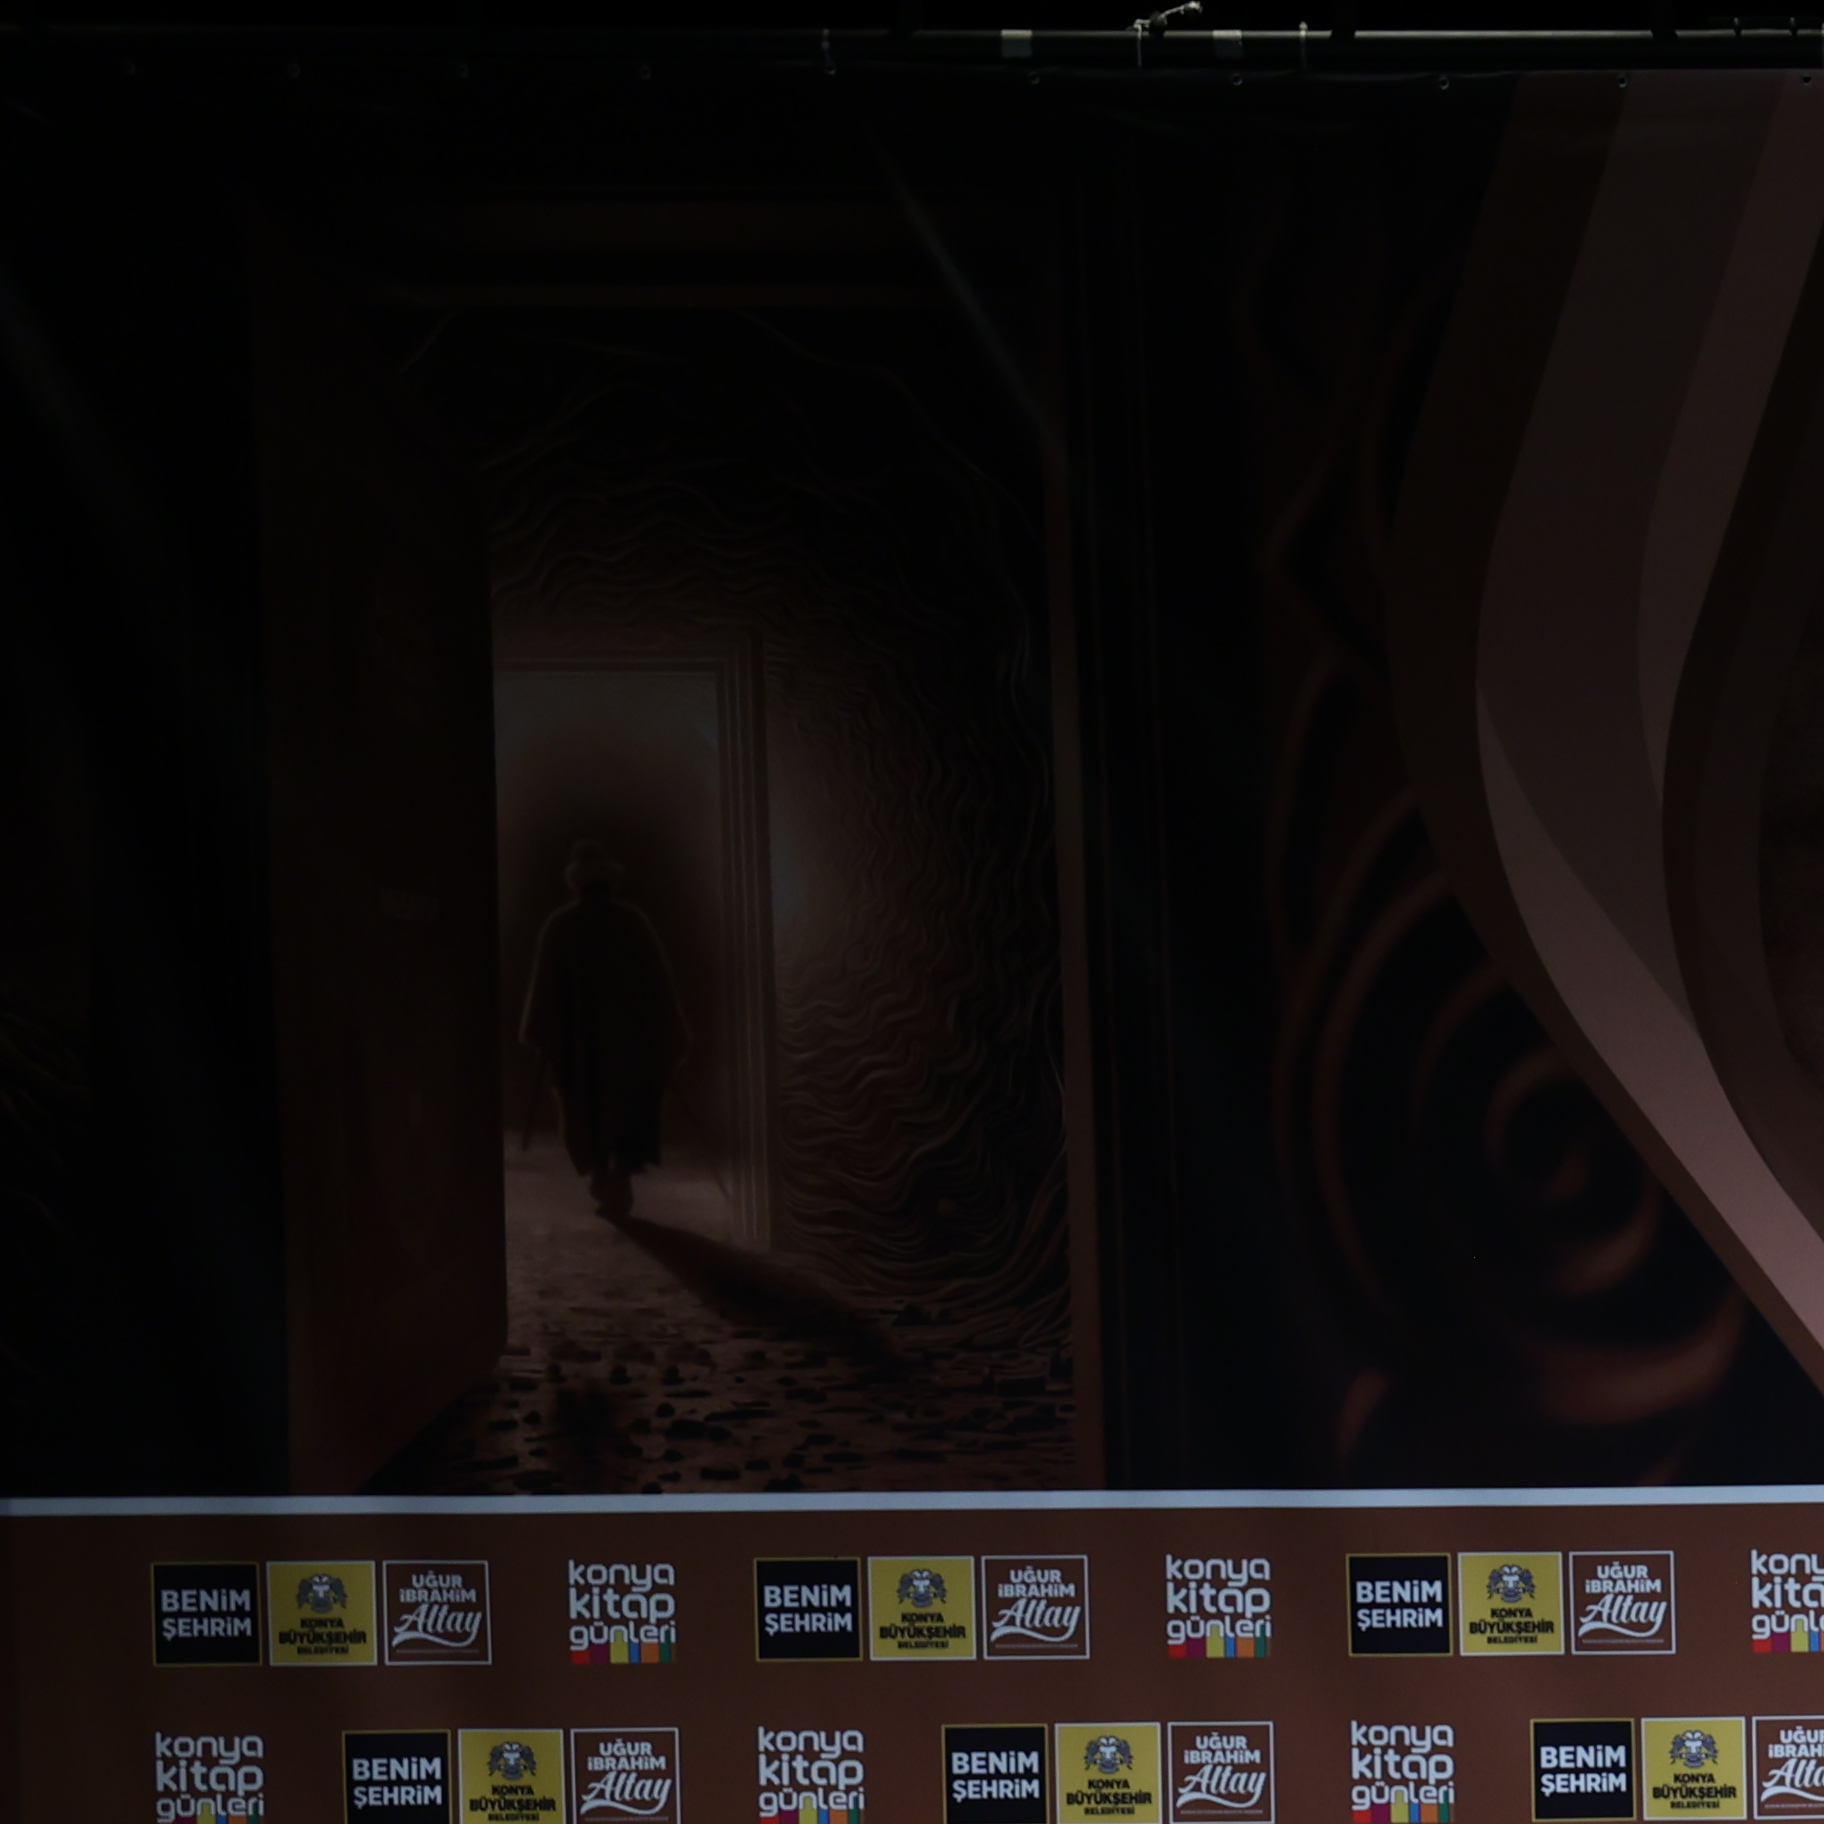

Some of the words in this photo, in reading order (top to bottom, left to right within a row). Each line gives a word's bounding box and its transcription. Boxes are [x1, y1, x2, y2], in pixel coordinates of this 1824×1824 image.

[568, 1559, 675, 1593] konya
[1010, 1565, 1062, 1583] UĞUR
[568, 1585, 676, 1625] kitap
[990, 1597, 1082, 1642] Altay
[569, 1619, 676, 1651] günleri
[155, 1731, 264, 1765] konya
[1351, 1720, 1454, 1753] konya
[155, 1758, 264, 1799] kitap
[1351, 1747, 1455, 1785] kitap
[1673, 1773, 1715, 1784] KONYA
[155, 1792, 264, 1824] günleri
[1351, 1780, 1455, 1811] günleri
